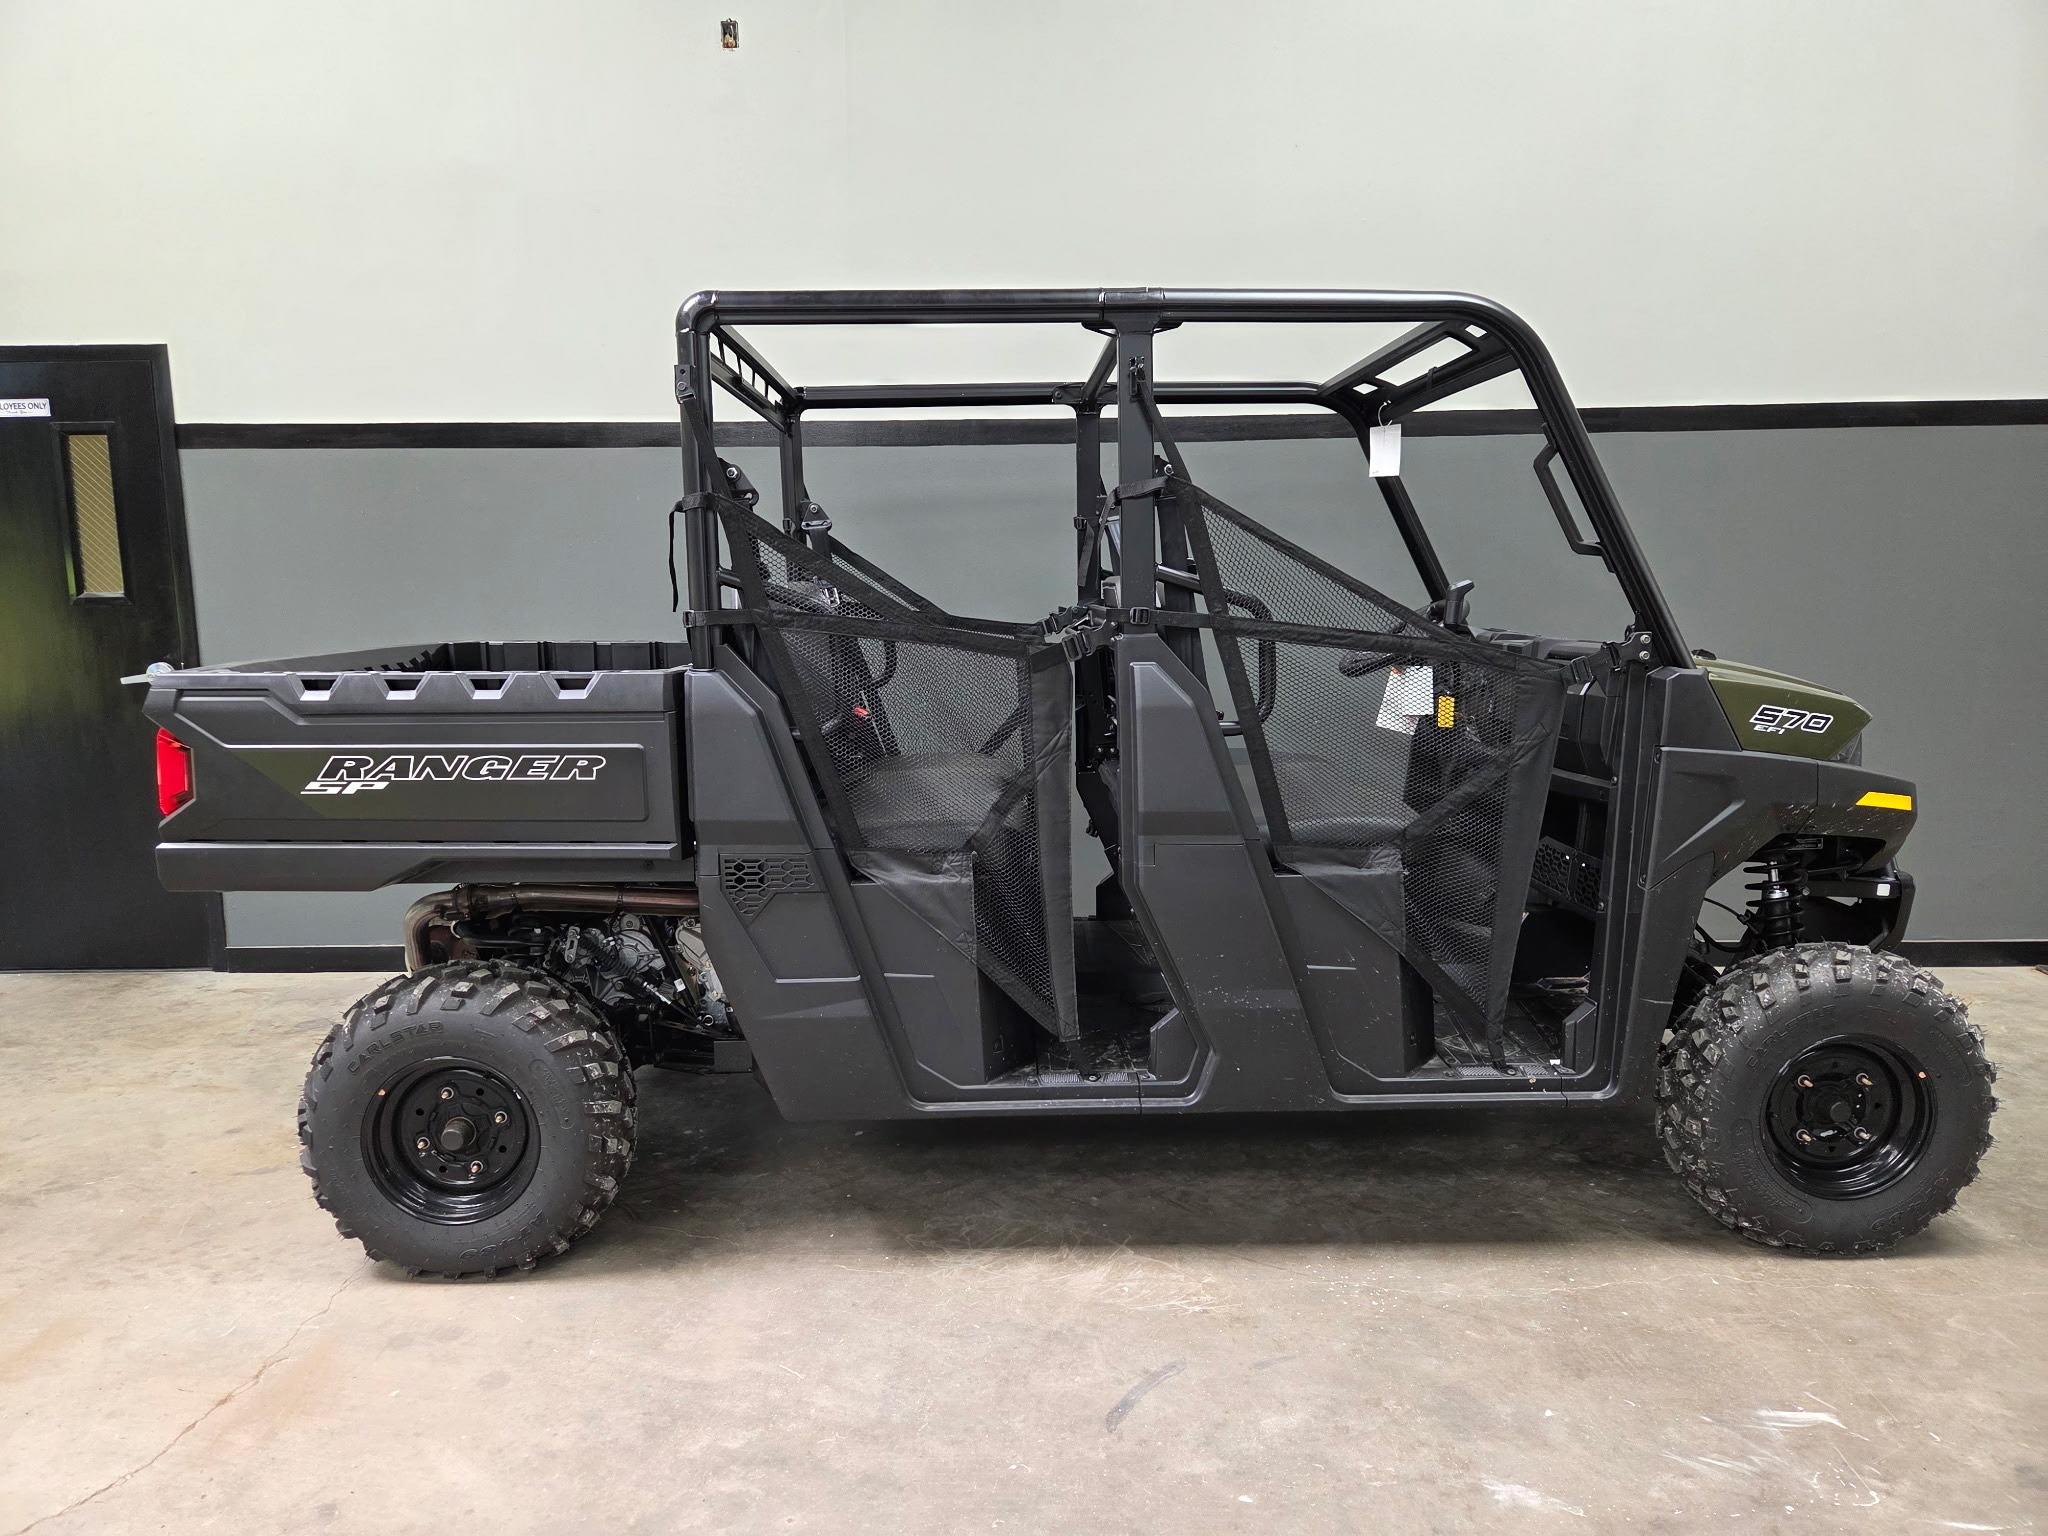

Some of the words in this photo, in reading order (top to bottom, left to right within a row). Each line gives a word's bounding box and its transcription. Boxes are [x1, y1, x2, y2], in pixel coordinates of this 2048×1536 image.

[27, 402, 47, 410] ONLY
[1749, 704, 1834, 734] 570
[1753, 724, 1786, 735] EFI
[316, 755, 607, 781] RANGER
[300, 781, 390, 795] SP
[346, 1020, 445, 1074] CARLSTAR
